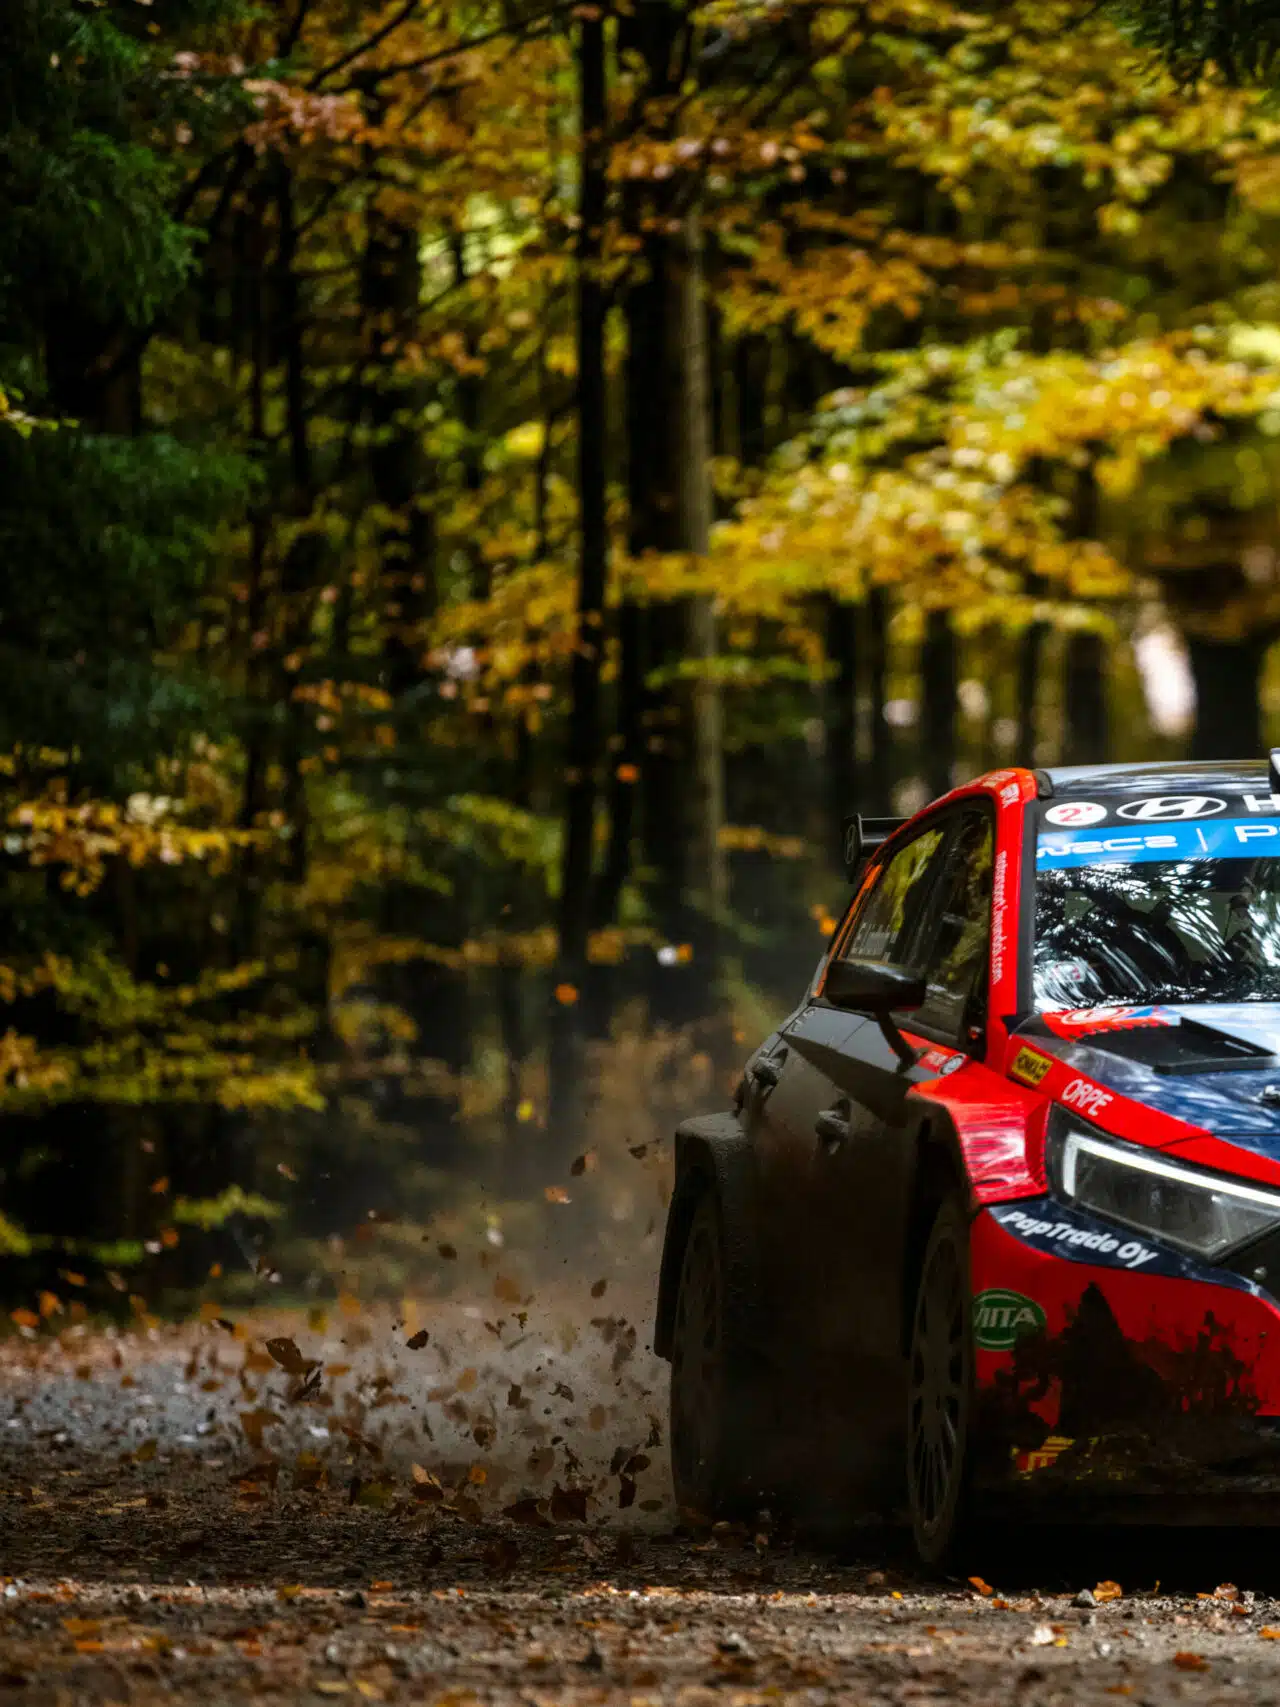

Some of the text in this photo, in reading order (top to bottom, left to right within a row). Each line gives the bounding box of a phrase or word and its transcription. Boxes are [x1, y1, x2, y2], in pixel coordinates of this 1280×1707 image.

[1061, 1078, 1113, 1117] ORPE
[999, 1211, 1159, 1269] PapTrade Oy
